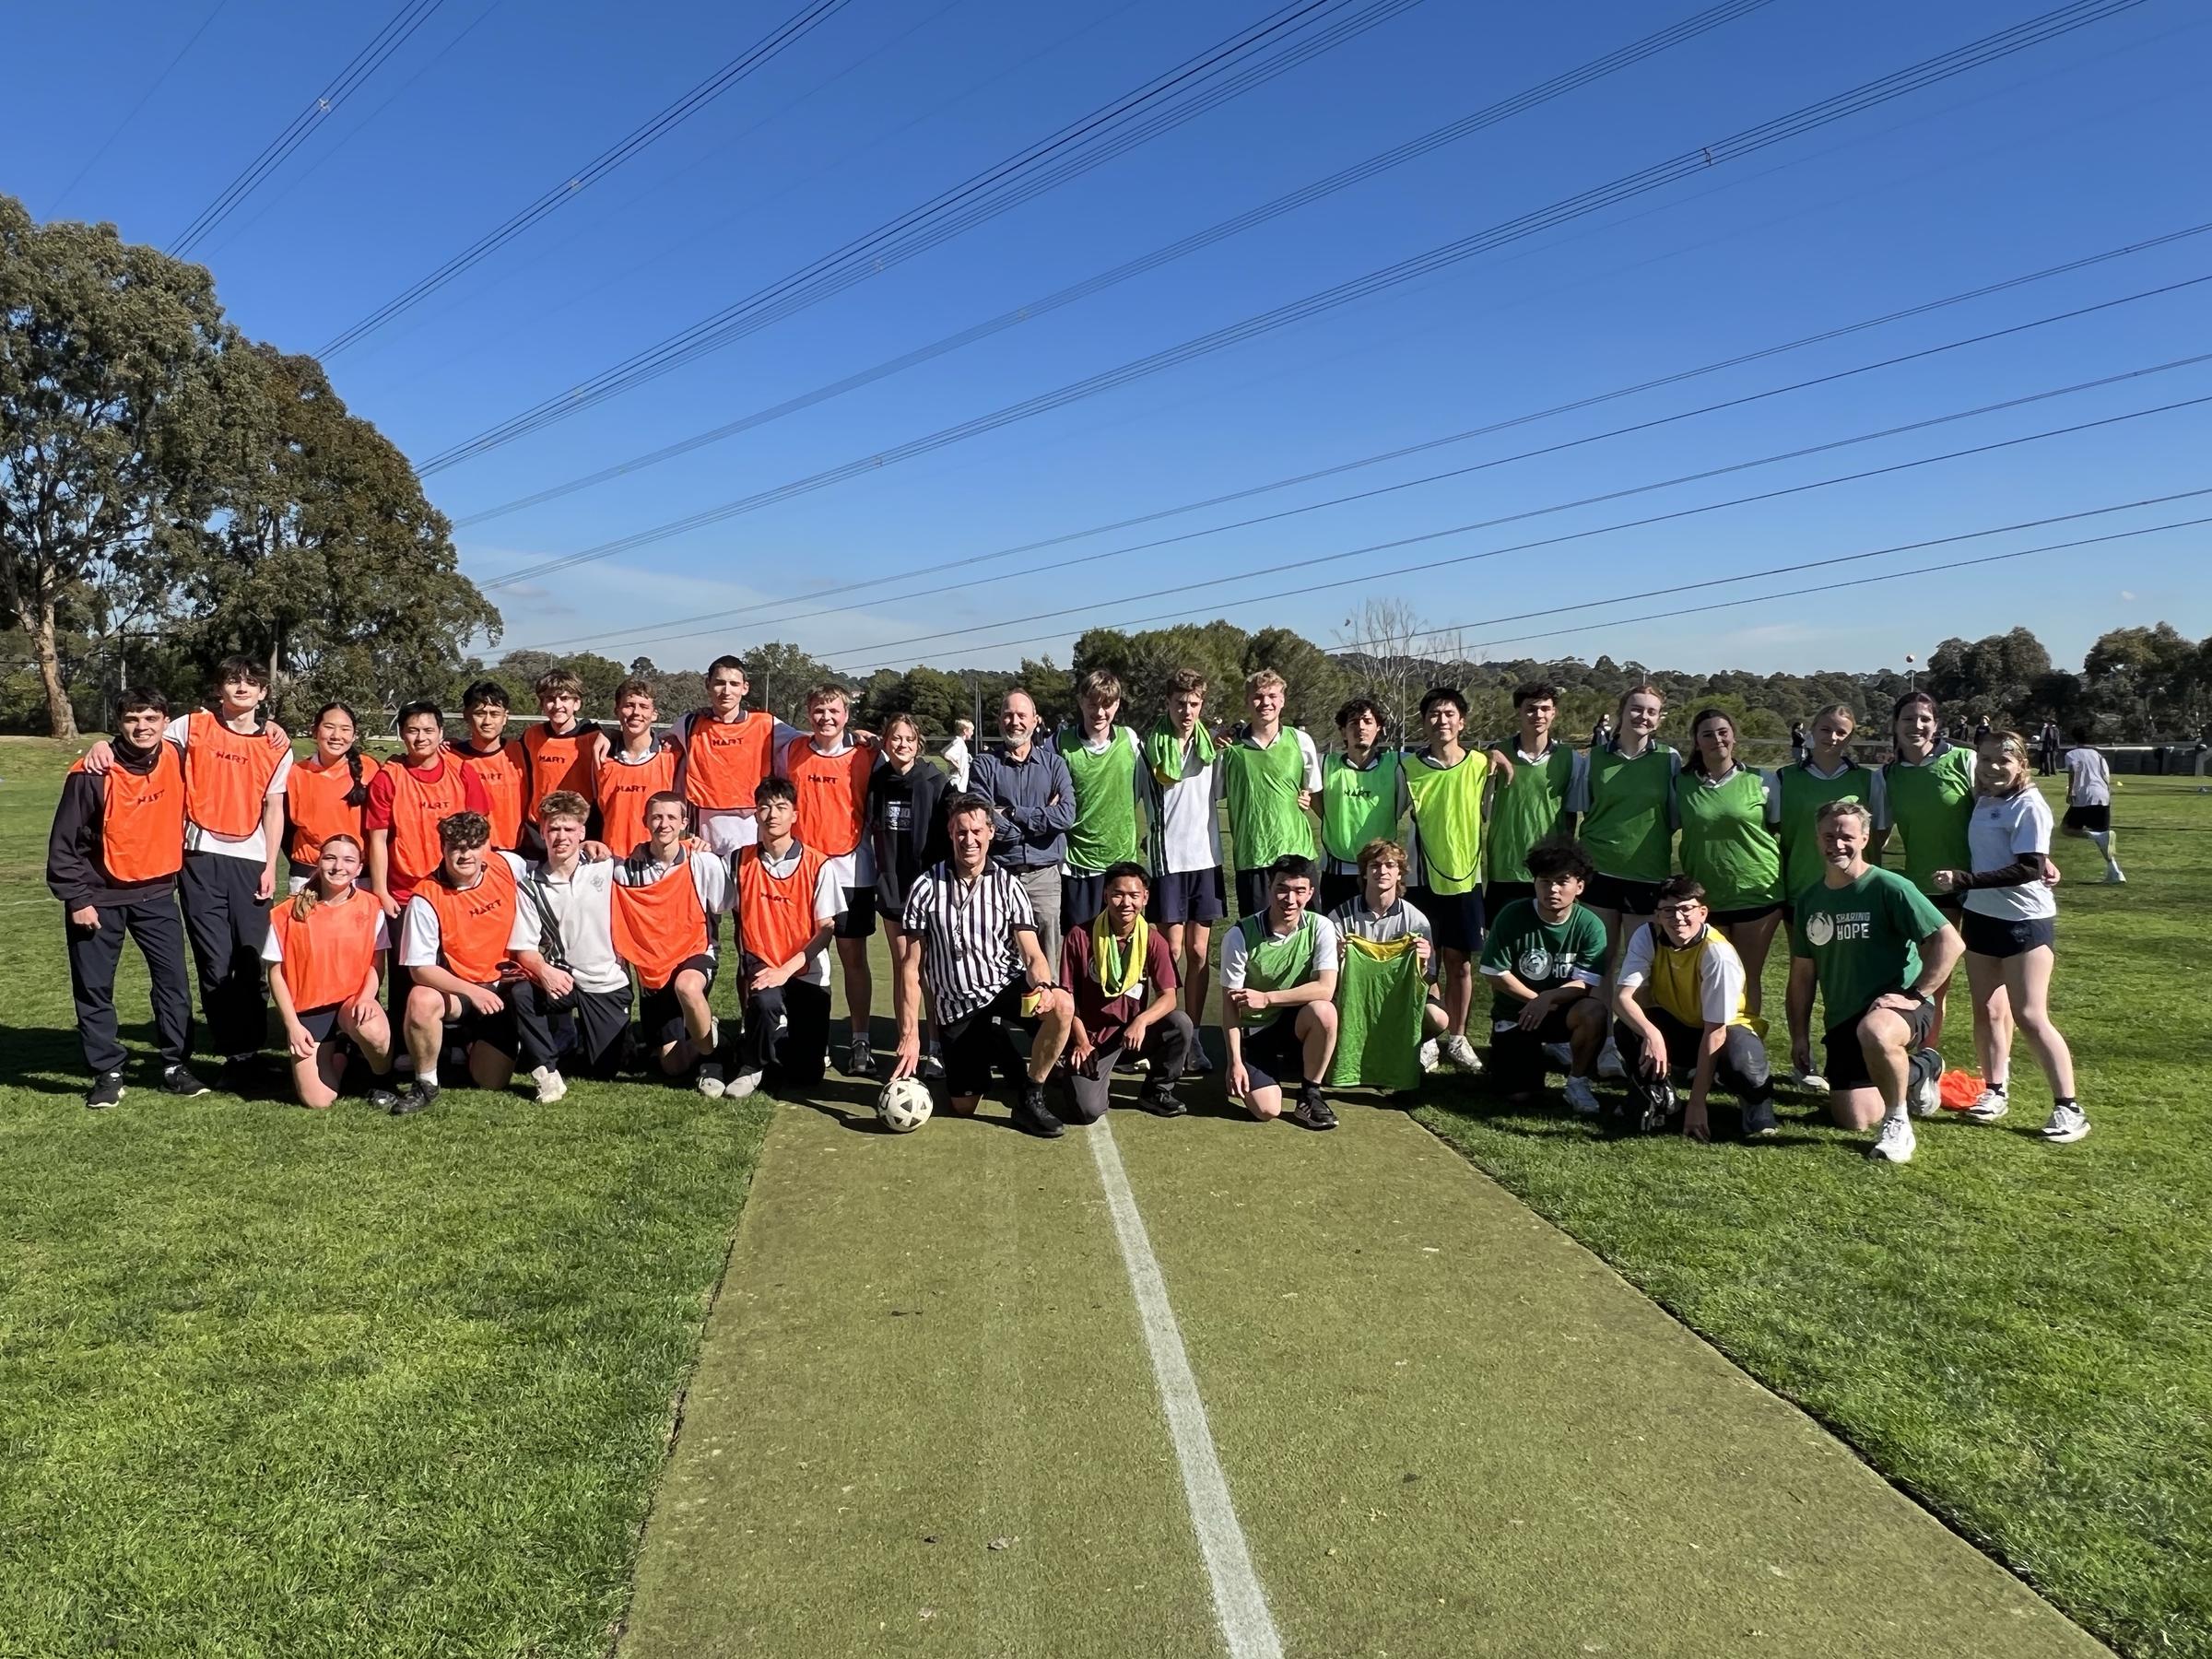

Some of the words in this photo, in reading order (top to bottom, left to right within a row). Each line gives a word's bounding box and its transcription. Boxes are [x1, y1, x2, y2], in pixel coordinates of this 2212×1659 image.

[712, 737, 745, 747] HART
[216, 751, 249, 765] HART
[538, 755, 566, 764] HART
[479, 772, 503, 781] ART
[807, 773, 840, 784] HART
[1344, 789, 1371, 798] HART
[469, 899, 501, 917] HART
[1835, 912, 1871, 924] SHARING
[1837, 923, 1870, 941] HOPE
